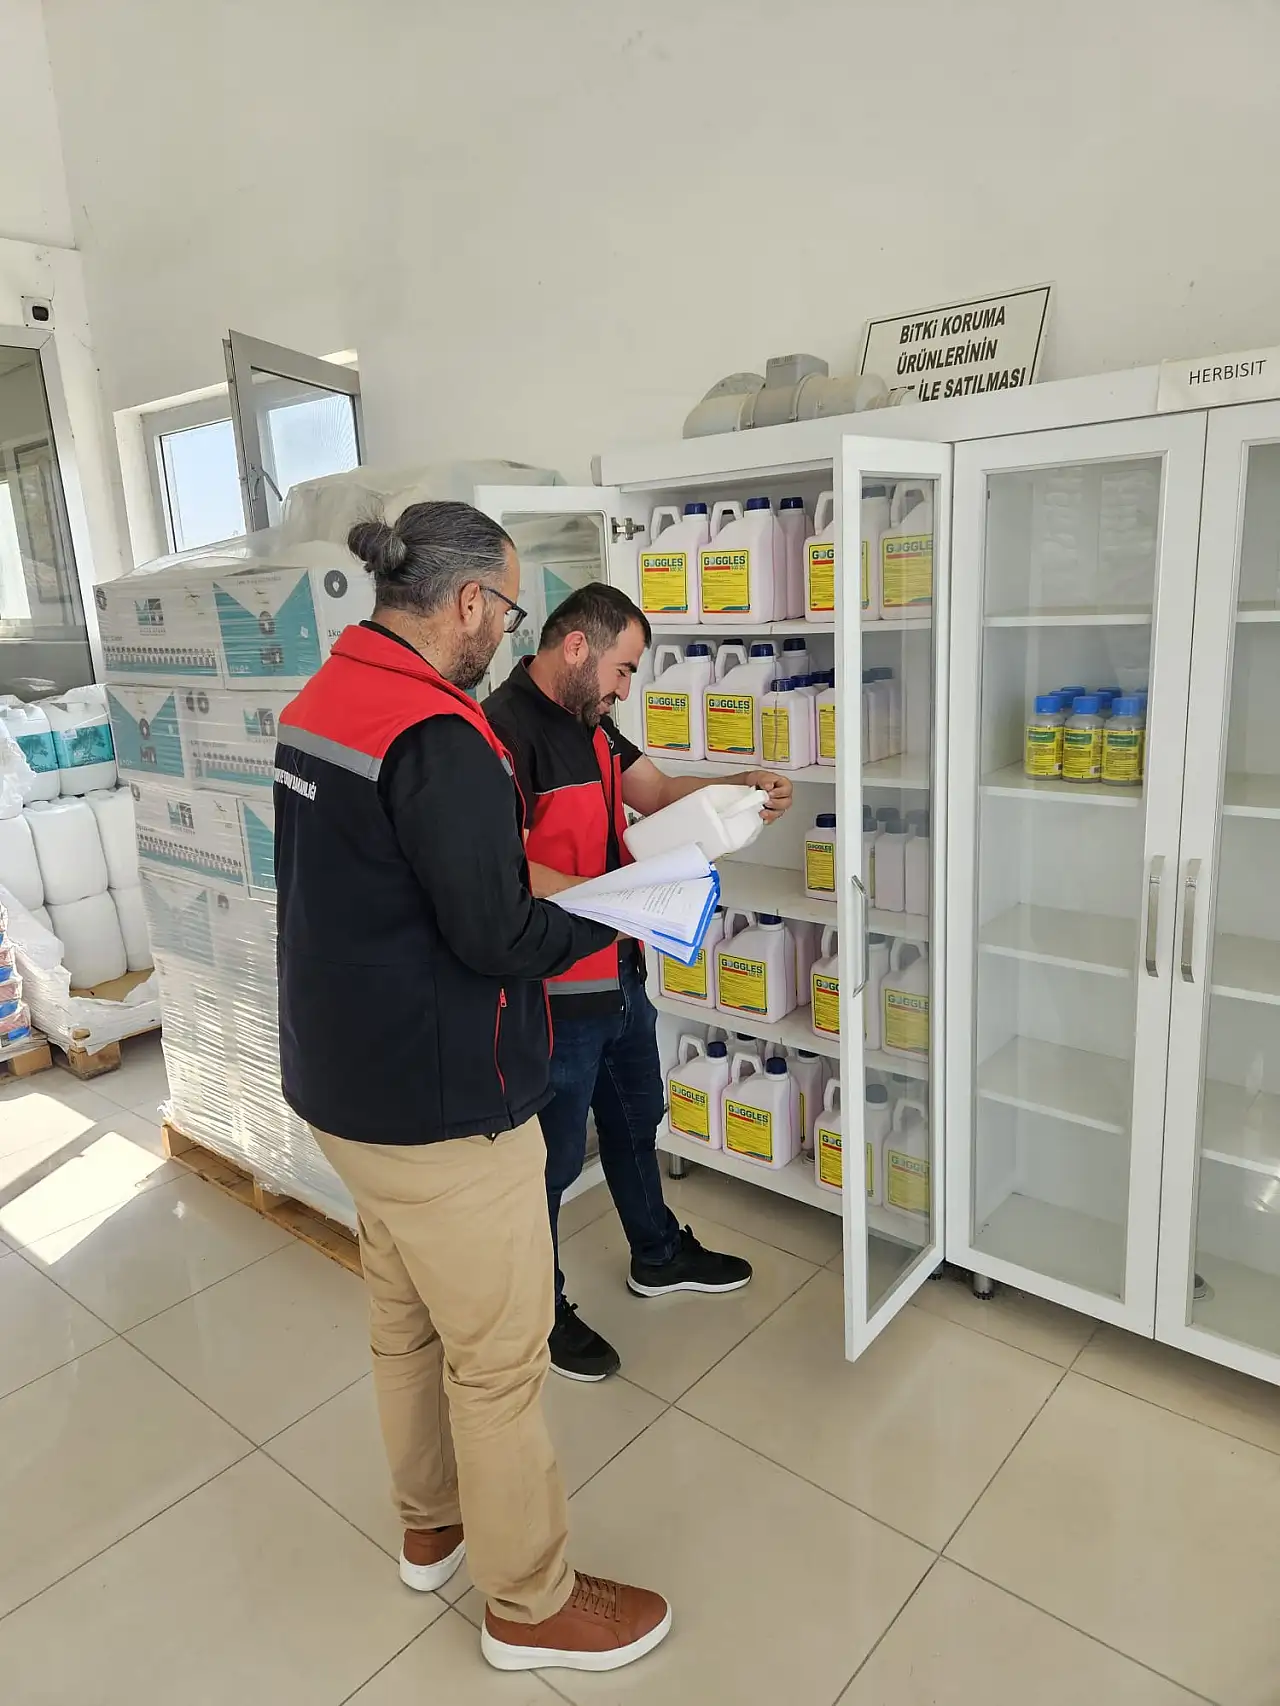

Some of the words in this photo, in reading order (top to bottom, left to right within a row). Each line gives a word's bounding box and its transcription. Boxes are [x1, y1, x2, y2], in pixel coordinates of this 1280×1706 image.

[940, 306, 1006, 337] KORUMA
[896, 336, 999, 375] ÜRÜNLERİNİN
[1189, 360, 1267, 385] HERBISIT
[918, 378, 941, 402] İLE
[943, 367, 1027, 399] SATILMASI
[886, 540, 933, 554] GOGGLE
[643, 557, 684, 568] GOGGLES
[703, 555, 746, 566] GOGGLES
[647, 696, 686, 707] GOGGLES
[708, 698, 750, 710] GOGGLES
[721, 958, 763, 974] GOGGLES
[888, 994, 929, 1009] GOGGLE
[671, 1084, 706, 1104] GOGGLES
[728, 1104, 769, 1123] GOGGLES
